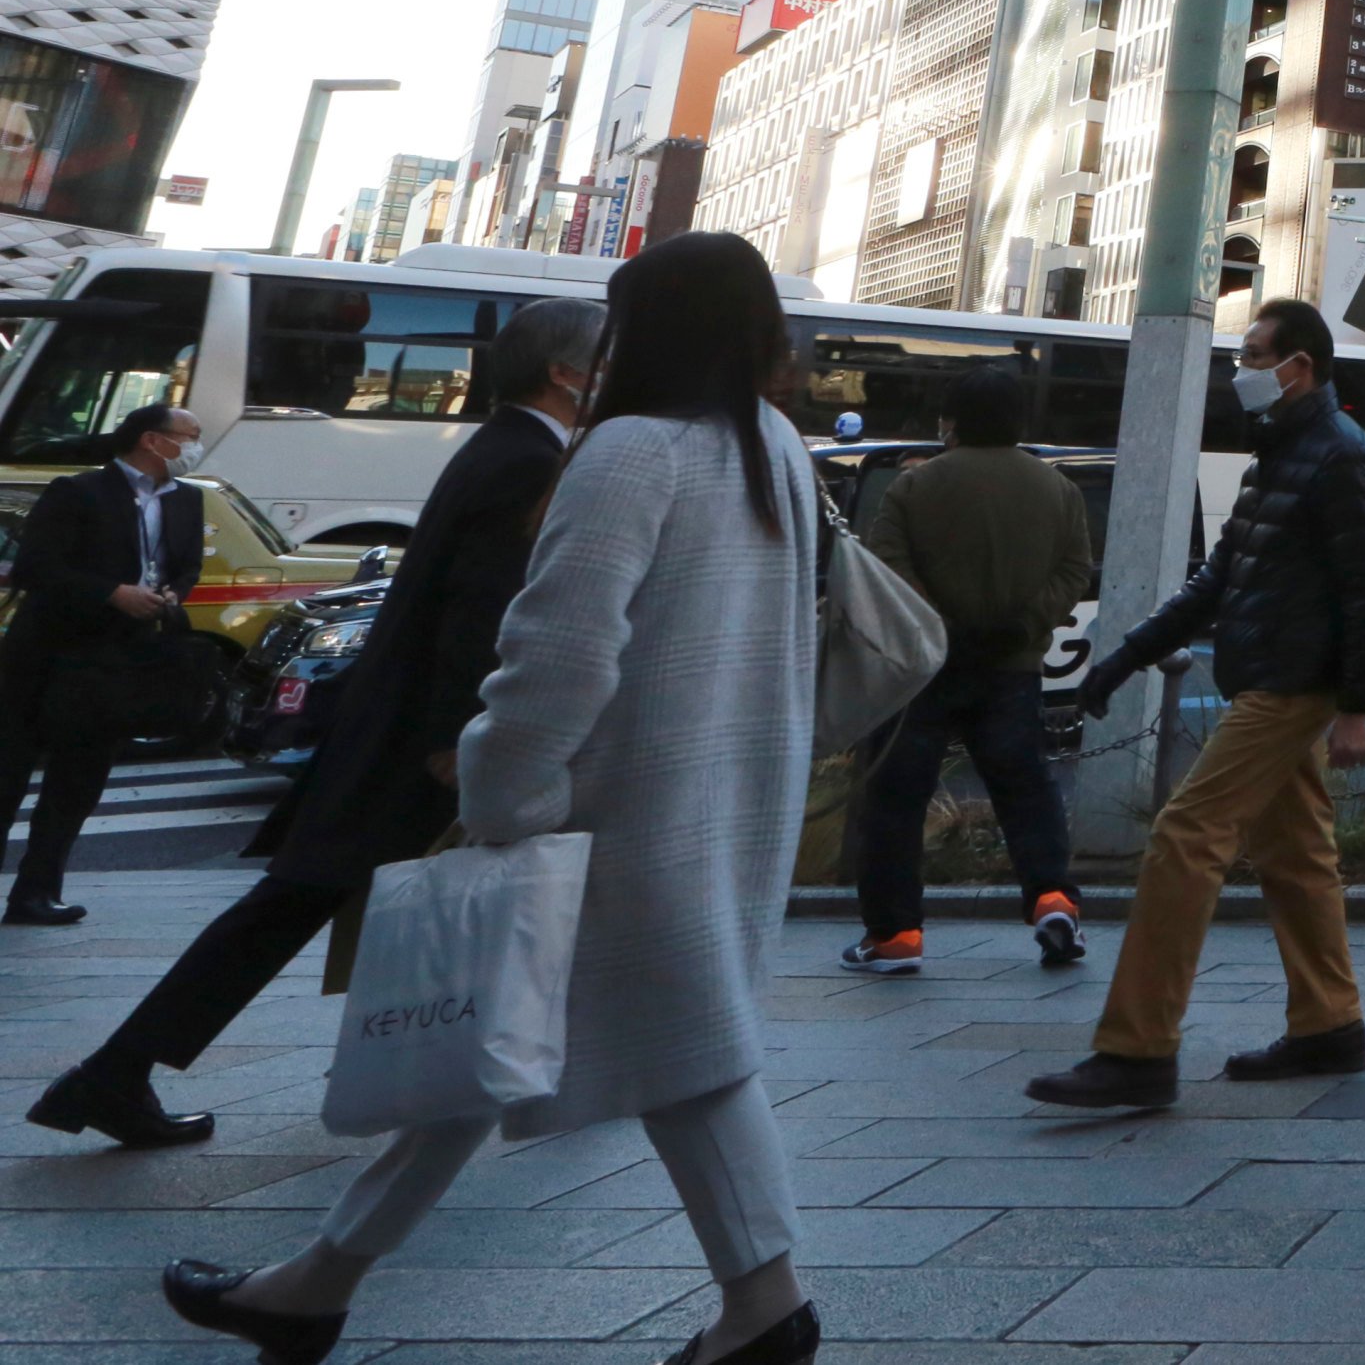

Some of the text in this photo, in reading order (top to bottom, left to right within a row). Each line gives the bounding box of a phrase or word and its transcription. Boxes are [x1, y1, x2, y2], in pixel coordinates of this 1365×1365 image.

[1355, 14, 1362, 23] 4
[1352, 41, 1359, 50] 3
[1348, 84, 1355, 93] B
[635, 174, 651, 212] docomo
[361, 996, 477, 1039] KEYUCA
